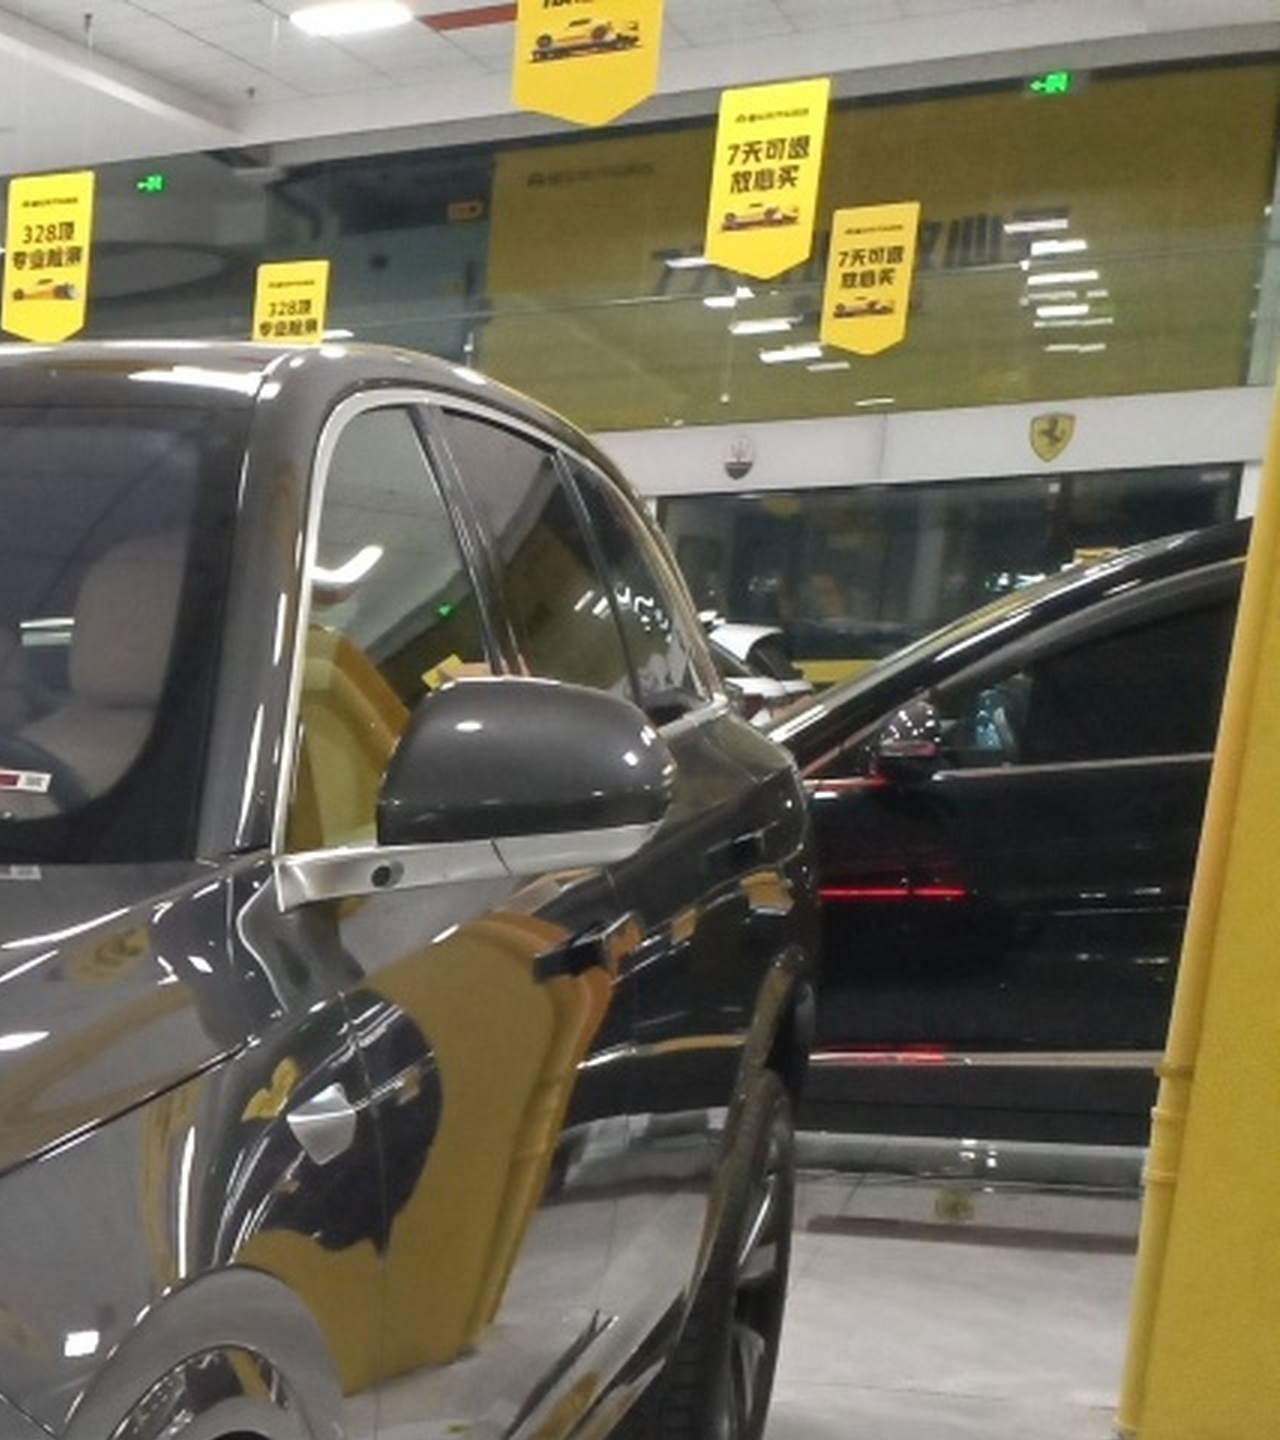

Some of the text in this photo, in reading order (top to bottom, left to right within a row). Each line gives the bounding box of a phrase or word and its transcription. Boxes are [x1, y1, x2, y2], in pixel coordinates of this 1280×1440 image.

[726, 134, 811, 166] 7天可退
[22, 221, 75, 244] 328项
